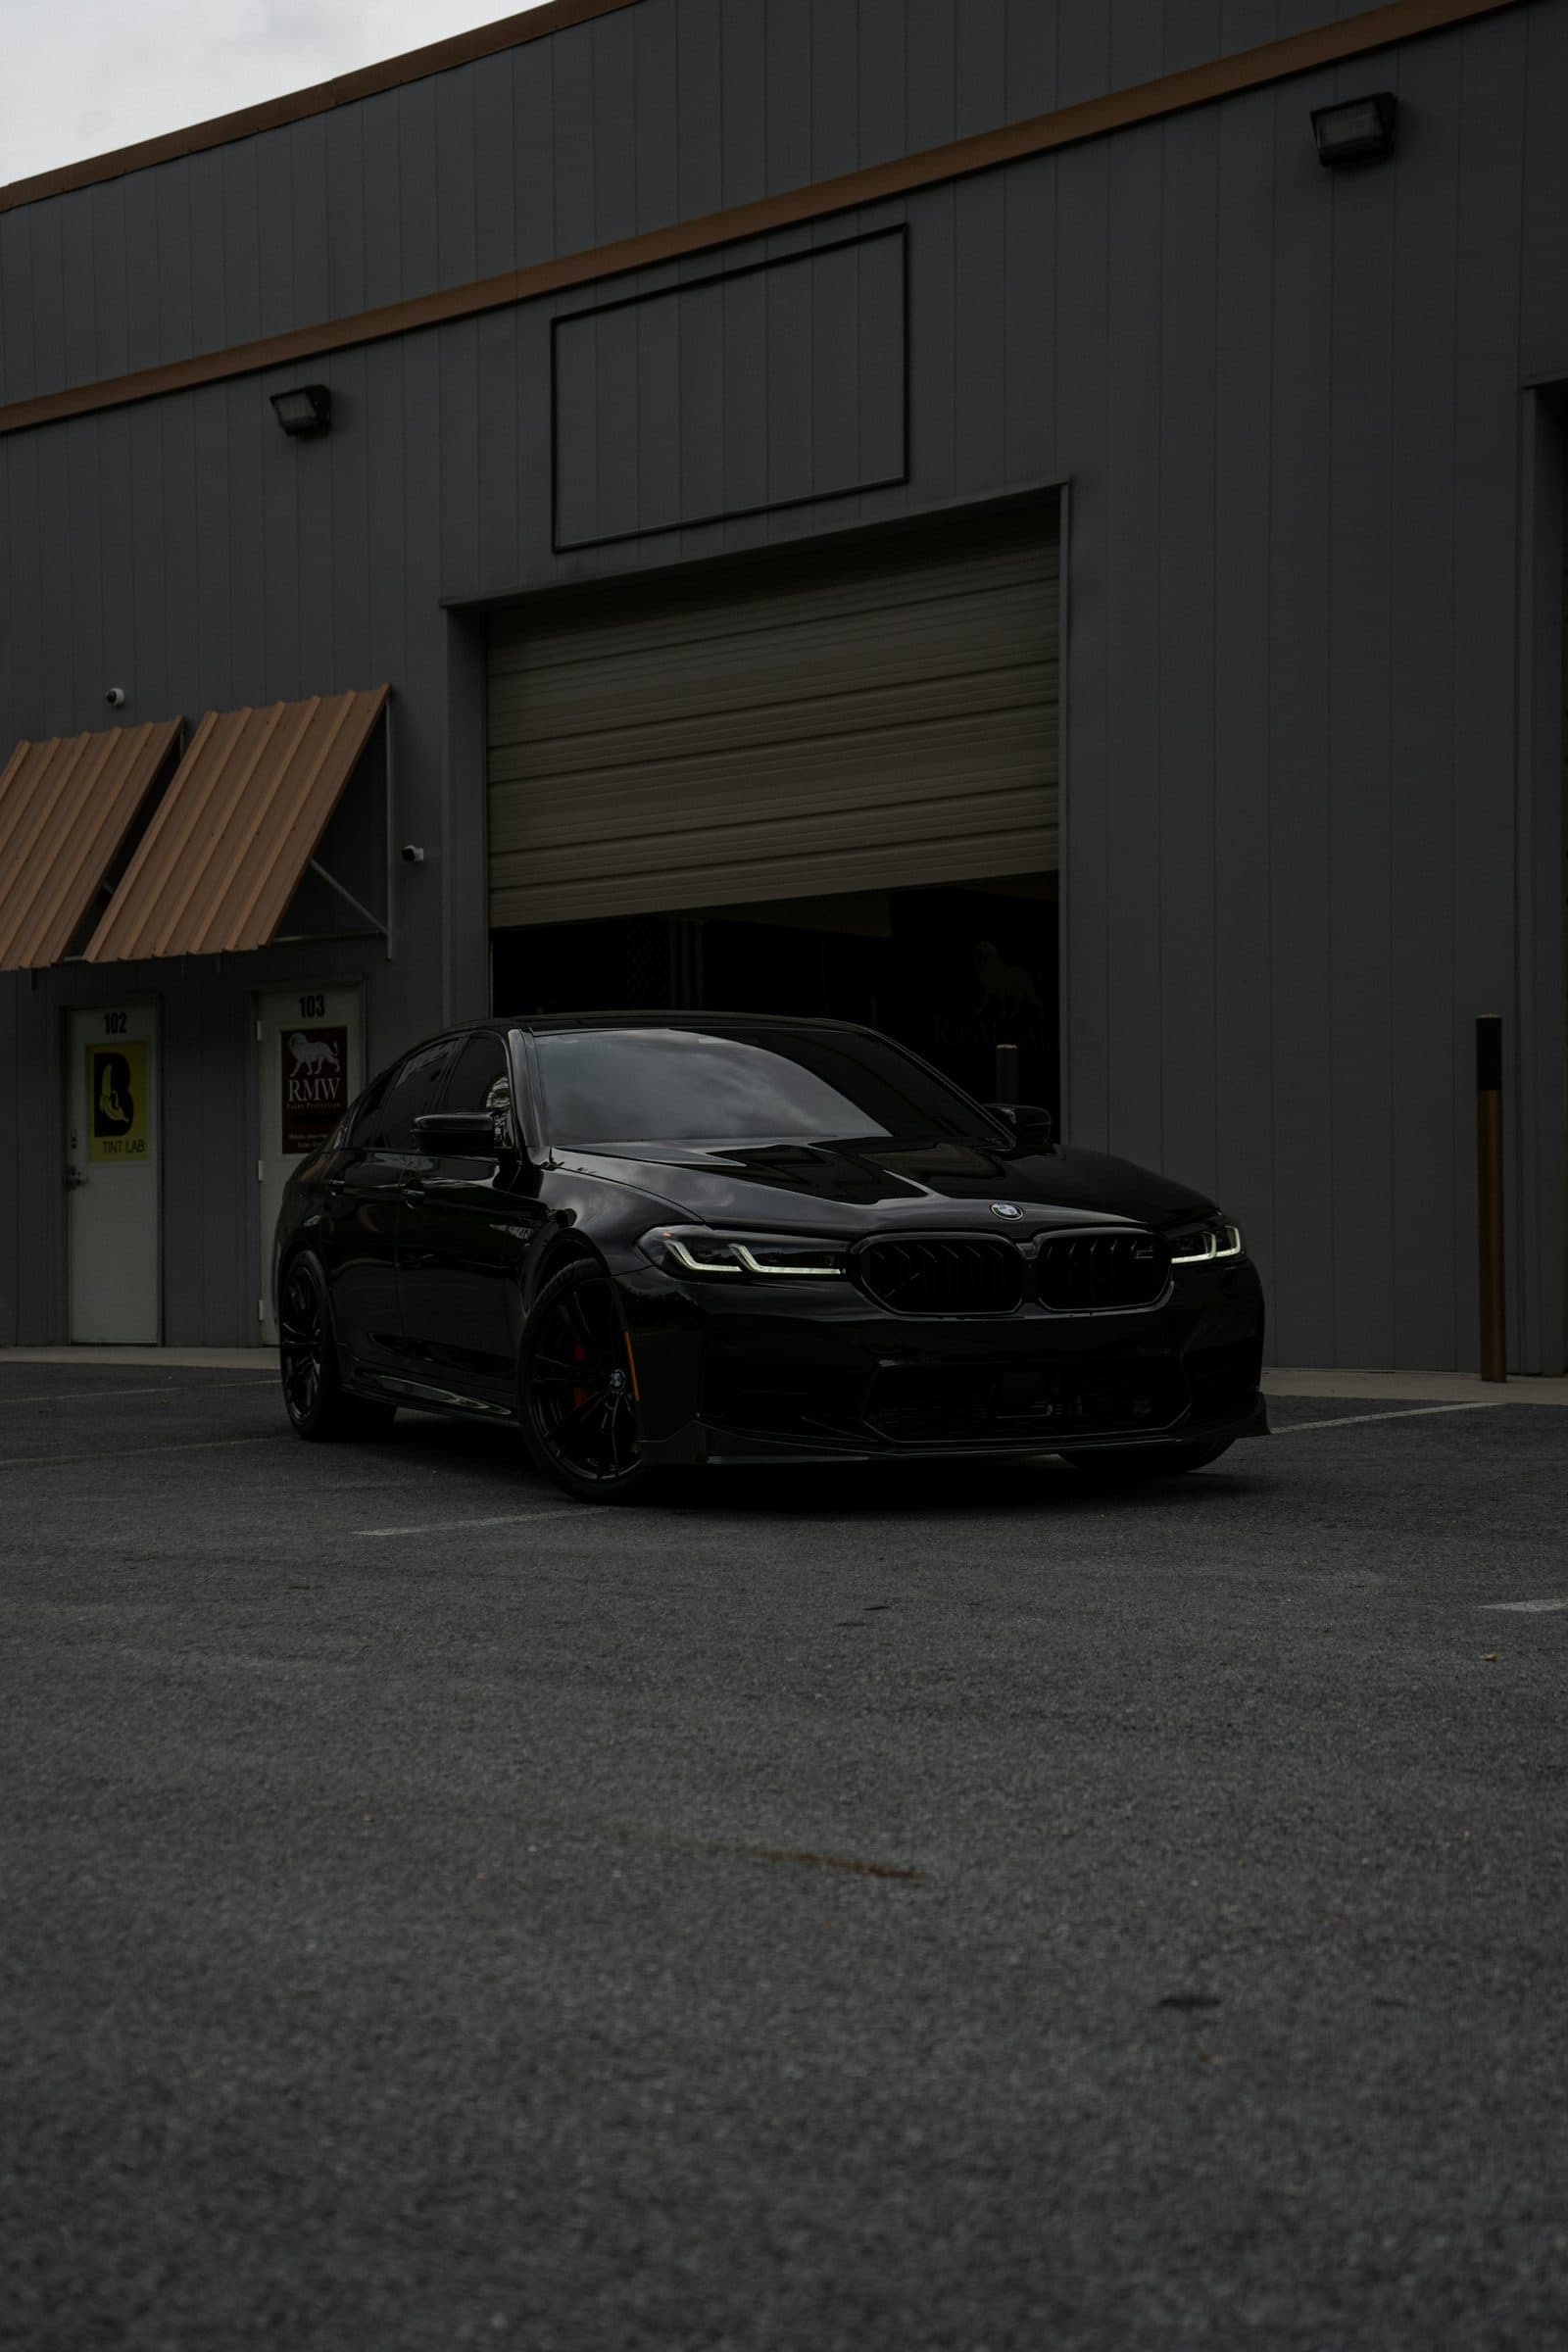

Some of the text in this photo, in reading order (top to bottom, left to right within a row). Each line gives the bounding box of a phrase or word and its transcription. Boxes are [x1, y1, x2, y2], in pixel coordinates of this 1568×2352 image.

[300, 995, 325, 1018] 103
[104, 1012, 127, 1035] 102
[287, 1077, 341, 1102] RMW
[102, 1141, 146, 1153] TINT LAB
